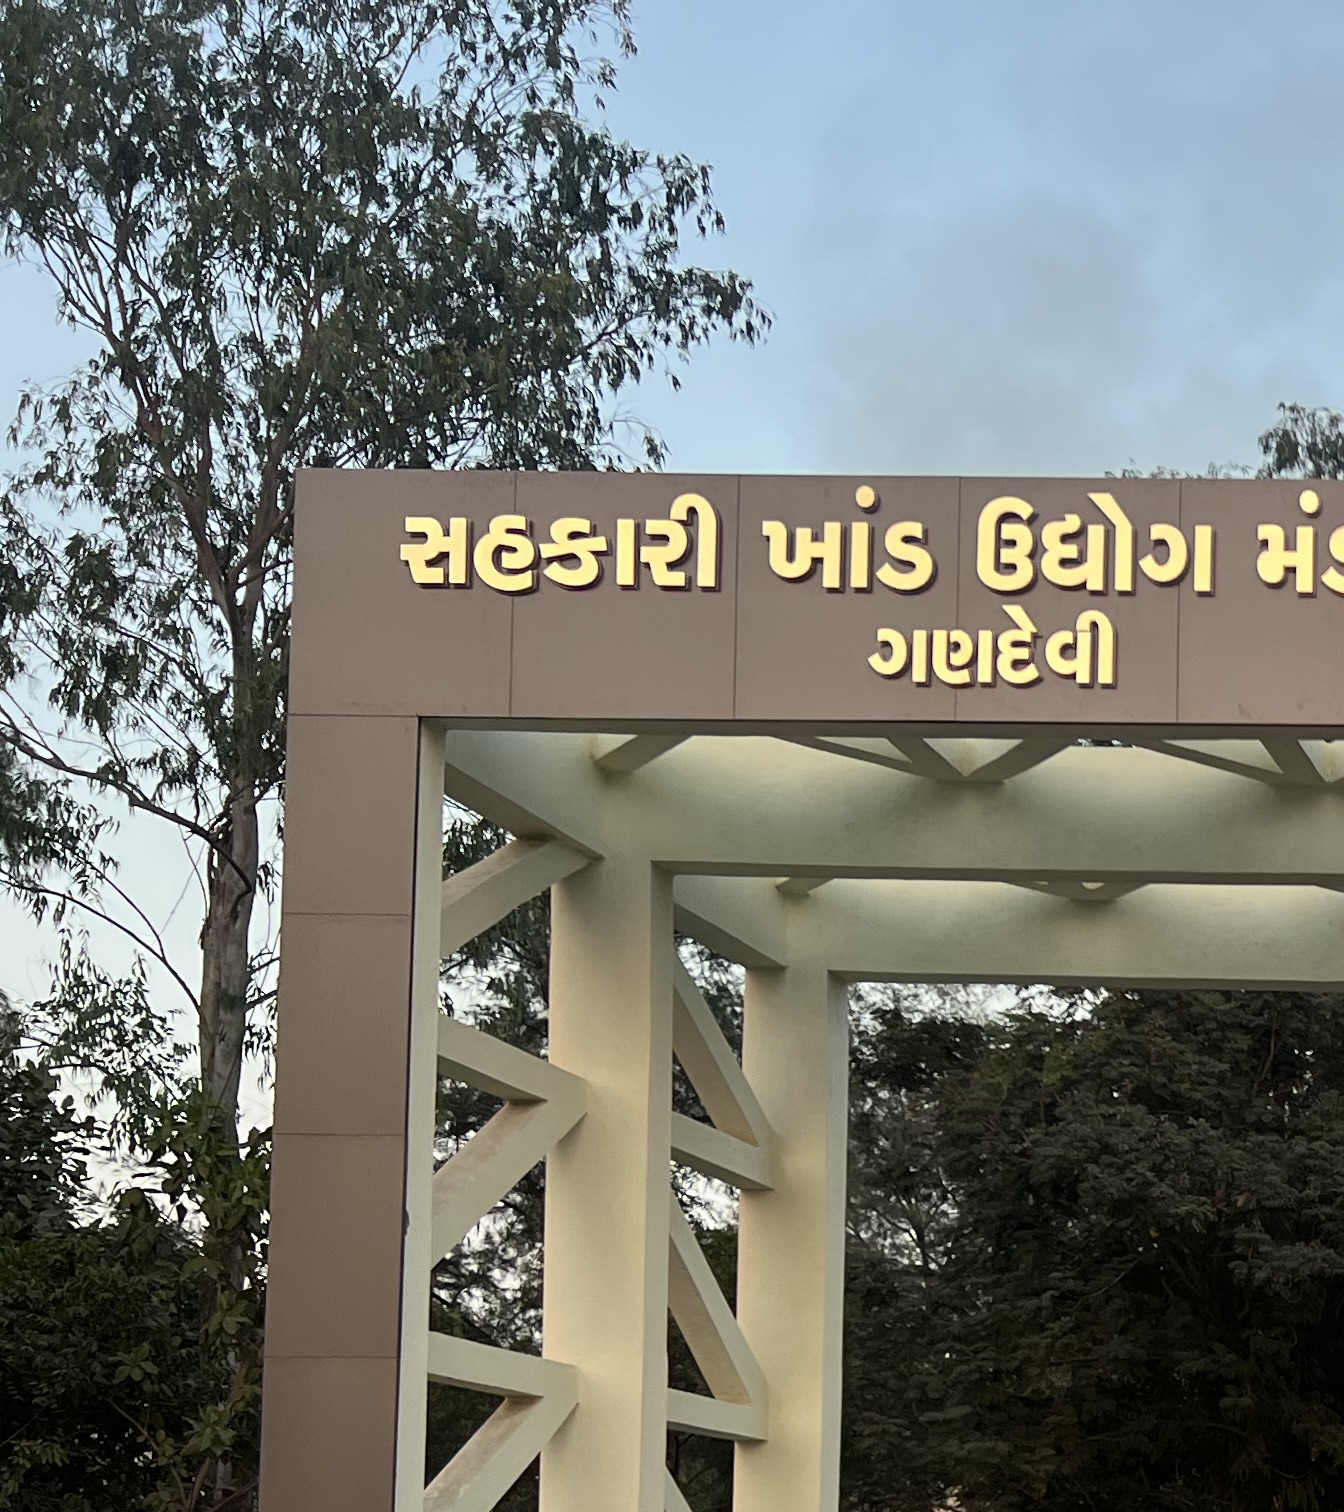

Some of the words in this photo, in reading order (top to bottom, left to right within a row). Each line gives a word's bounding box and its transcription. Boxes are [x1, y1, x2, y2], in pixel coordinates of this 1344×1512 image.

[399, 491, 719, 593] સહકારી
[761, 484, 935, 592] ખાંડ
[867, 603, 1116, 686] ગણદેવી
